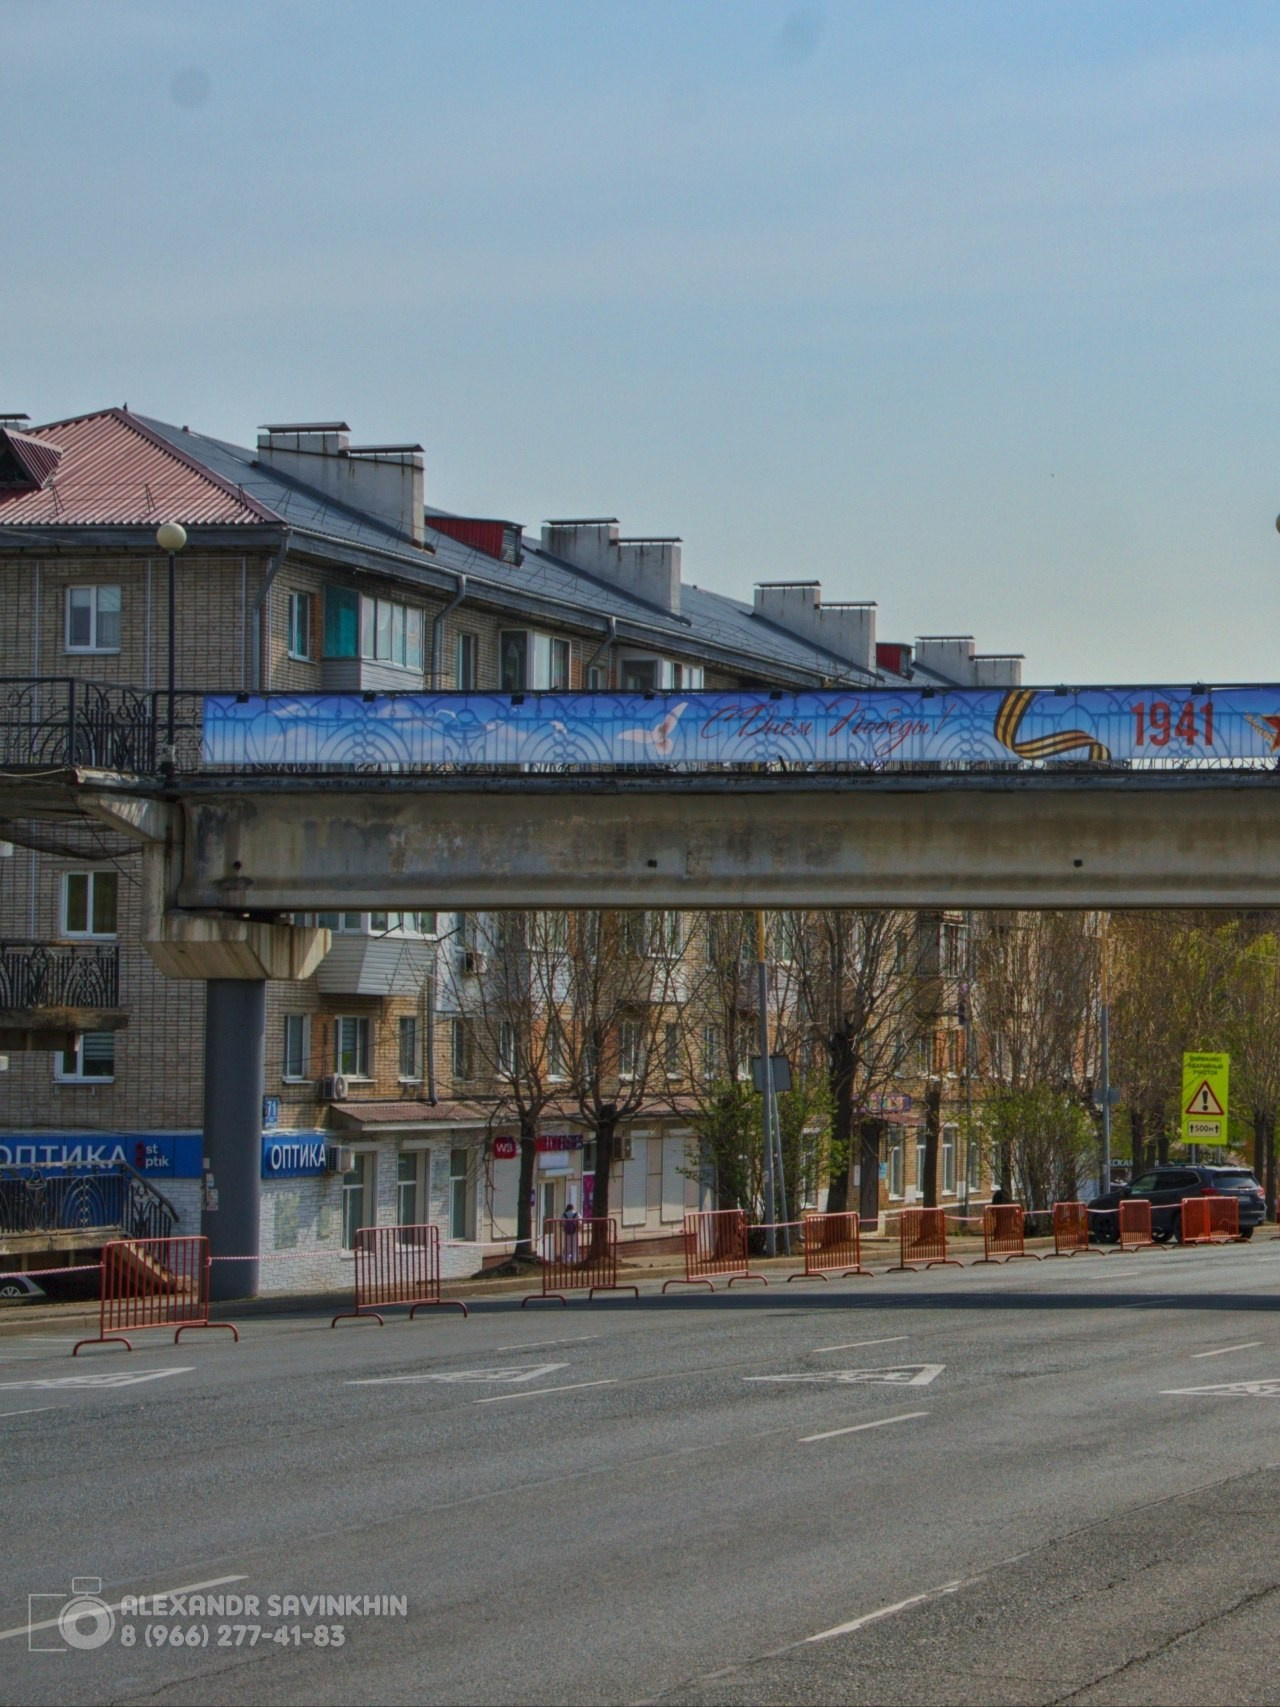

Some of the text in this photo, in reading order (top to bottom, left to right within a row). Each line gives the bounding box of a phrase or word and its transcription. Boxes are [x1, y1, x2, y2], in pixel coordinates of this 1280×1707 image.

[1130, 701, 1214, 747] 1941
[266, 1100, 277, 1117] 71
[271, 1144, 327, 1170] ОПТИКА
